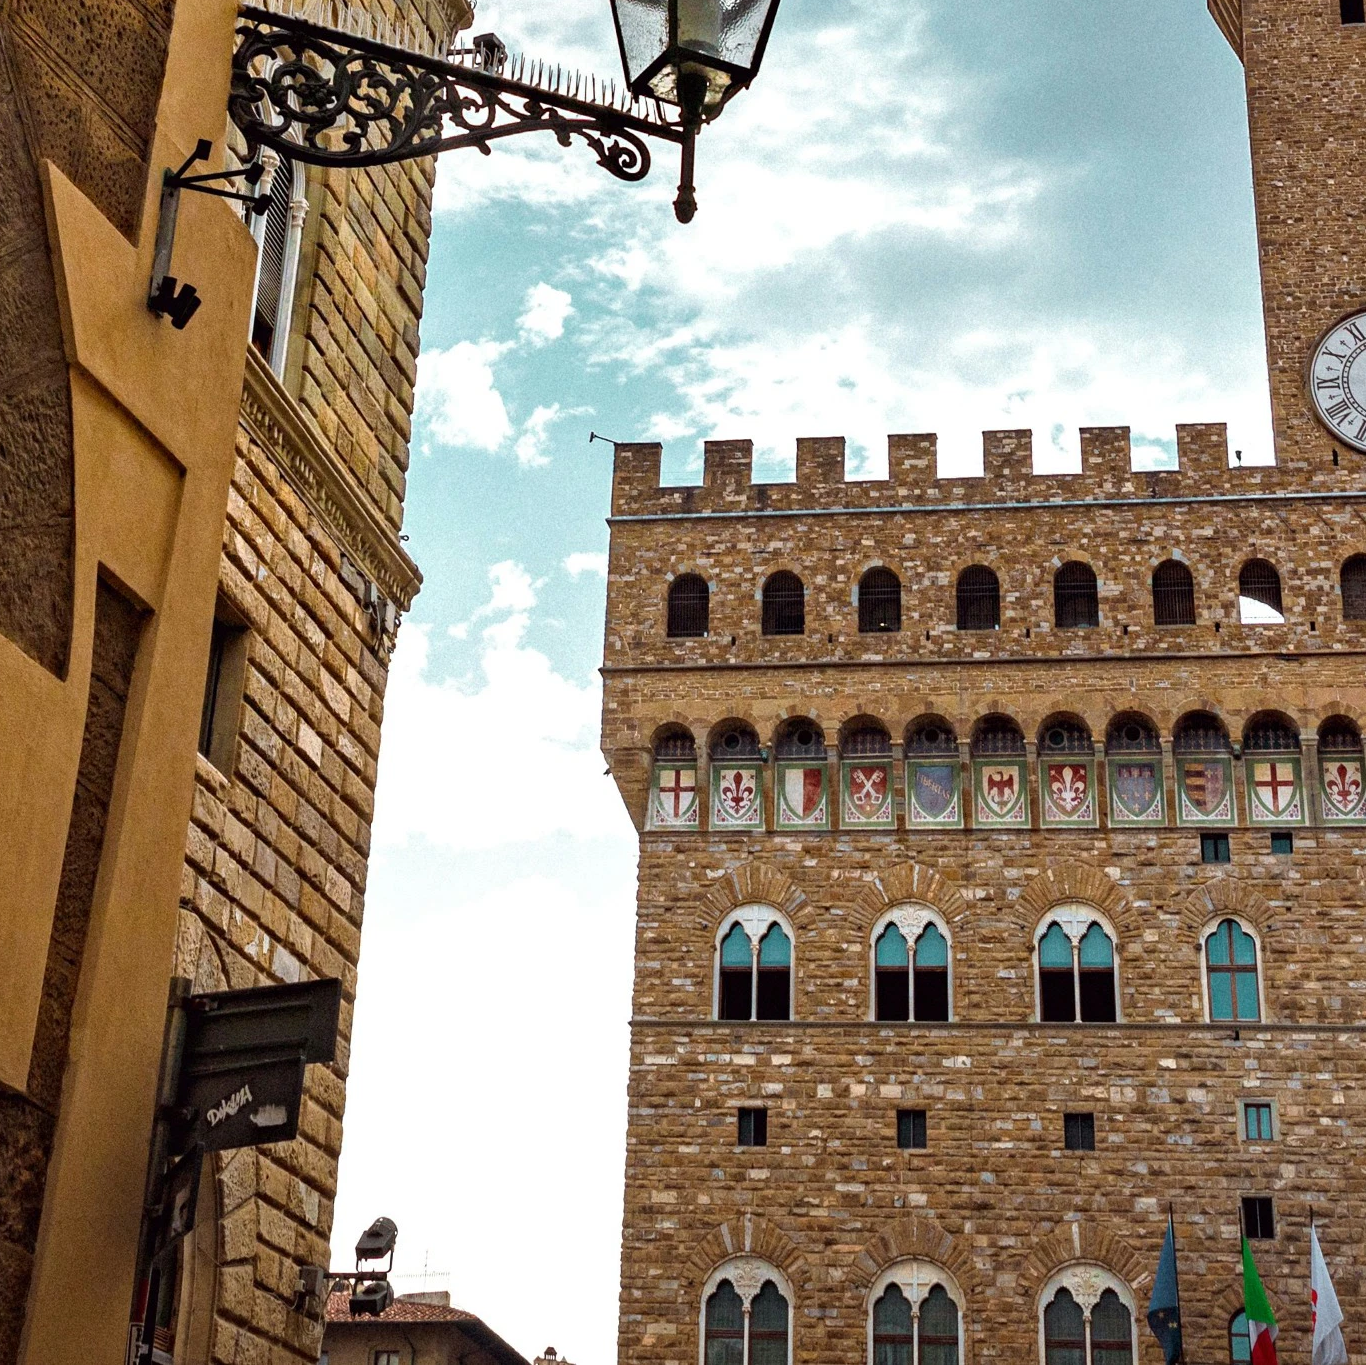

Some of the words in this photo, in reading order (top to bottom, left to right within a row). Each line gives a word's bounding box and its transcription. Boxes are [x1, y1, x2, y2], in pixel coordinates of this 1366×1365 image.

[1344, 322, 1366, 345] XI
[1321, 346, 1346, 364] X
[1316, 375, 1340, 390] IX
[1325, 397, 1352, 427] VIII
